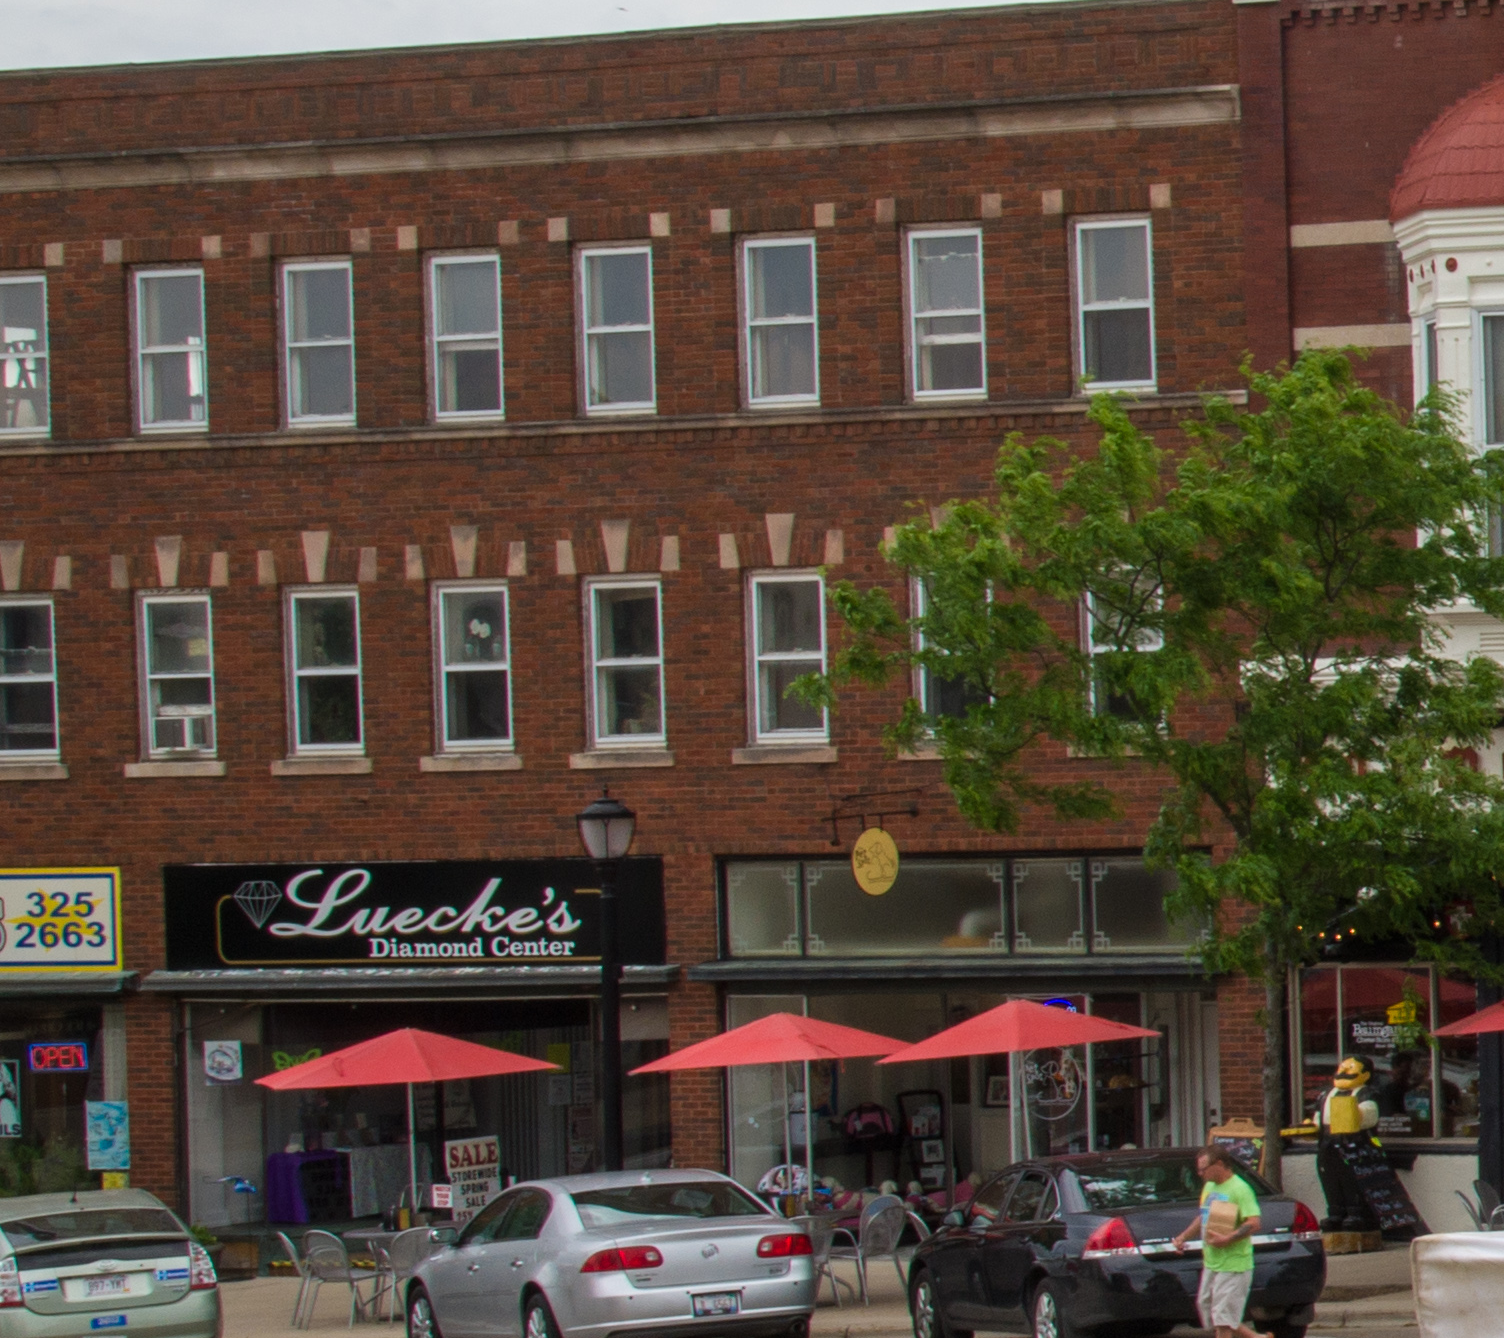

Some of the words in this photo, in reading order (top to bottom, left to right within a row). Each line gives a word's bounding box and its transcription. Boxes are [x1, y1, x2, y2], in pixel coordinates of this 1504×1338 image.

[27, 891, 95, 918] 325
[269, 868, 582, 936] Luecke's
[15, 922, 107, 948] 2663
[369, 937, 484, 958] Diamond
[491, 936, 575, 956] Center
[31, 1045, 86, 1069] OPEN
[450, 1141, 499, 1168] SALE
[451, 1167, 497, 1183] STOREWIDE
[461, 1182, 489, 1195] SPRING
[466, 1196, 486, 1209] SALE
